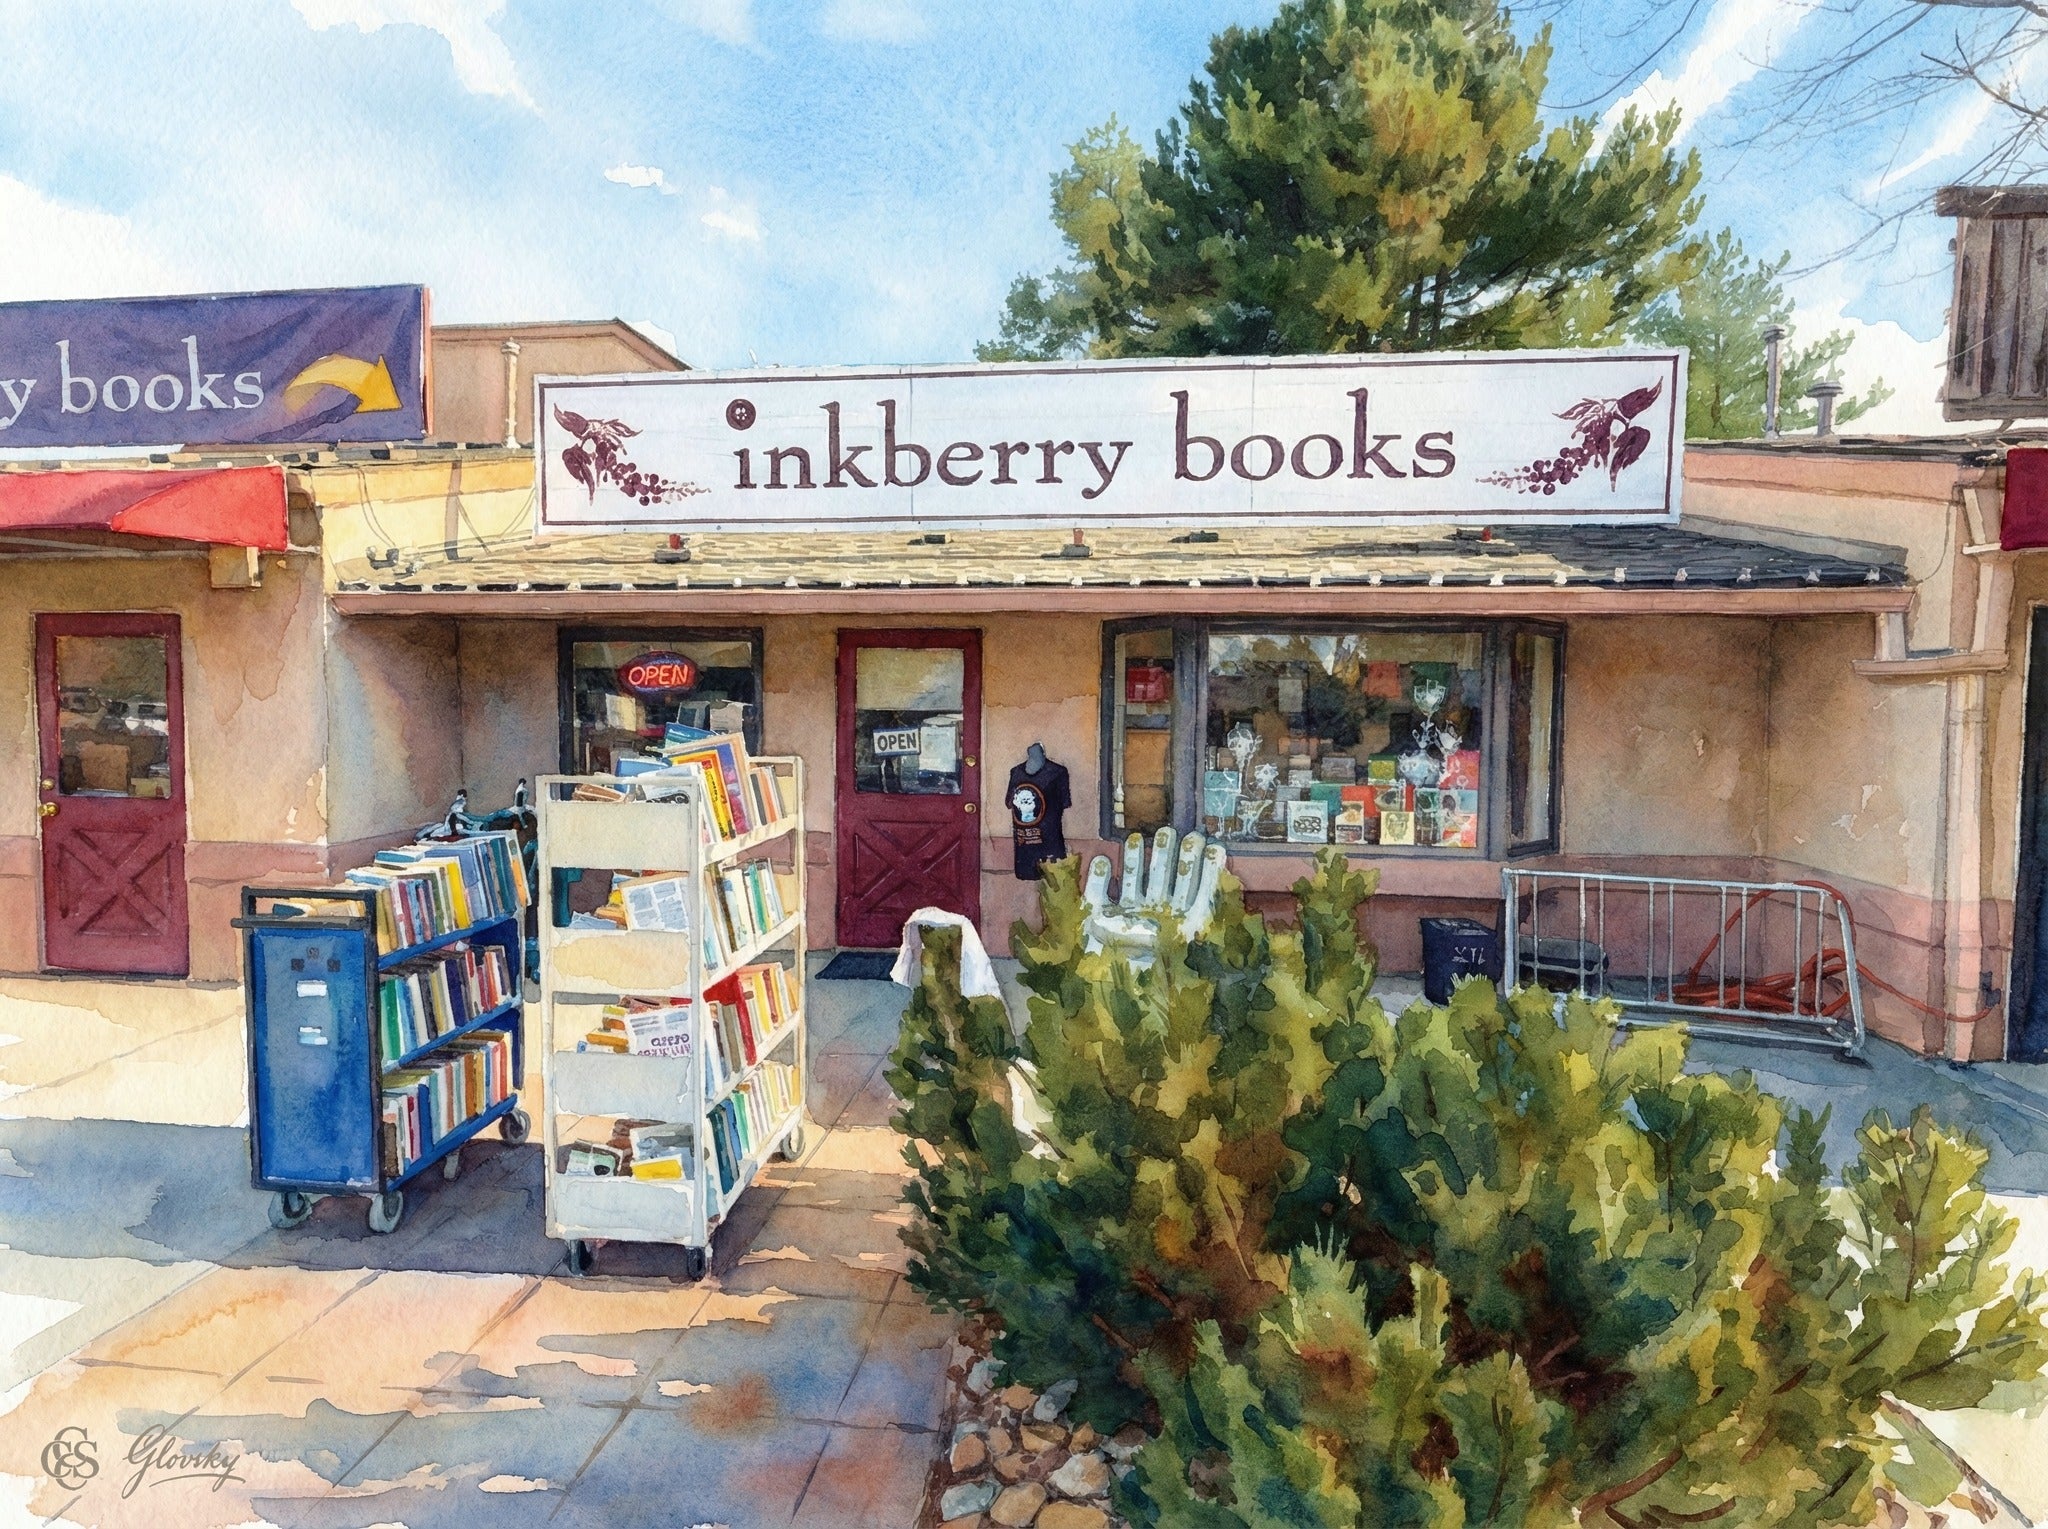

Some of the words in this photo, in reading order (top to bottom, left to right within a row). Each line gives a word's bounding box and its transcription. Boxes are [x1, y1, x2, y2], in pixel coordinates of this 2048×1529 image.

[56, 335, 265, 413] books
[725, 398, 1133, 500] inkberry
[1169, 387, 1456, 482] books
[628, 664, 689, 685] OPEN
[877, 732, 917, 751] OPEN
